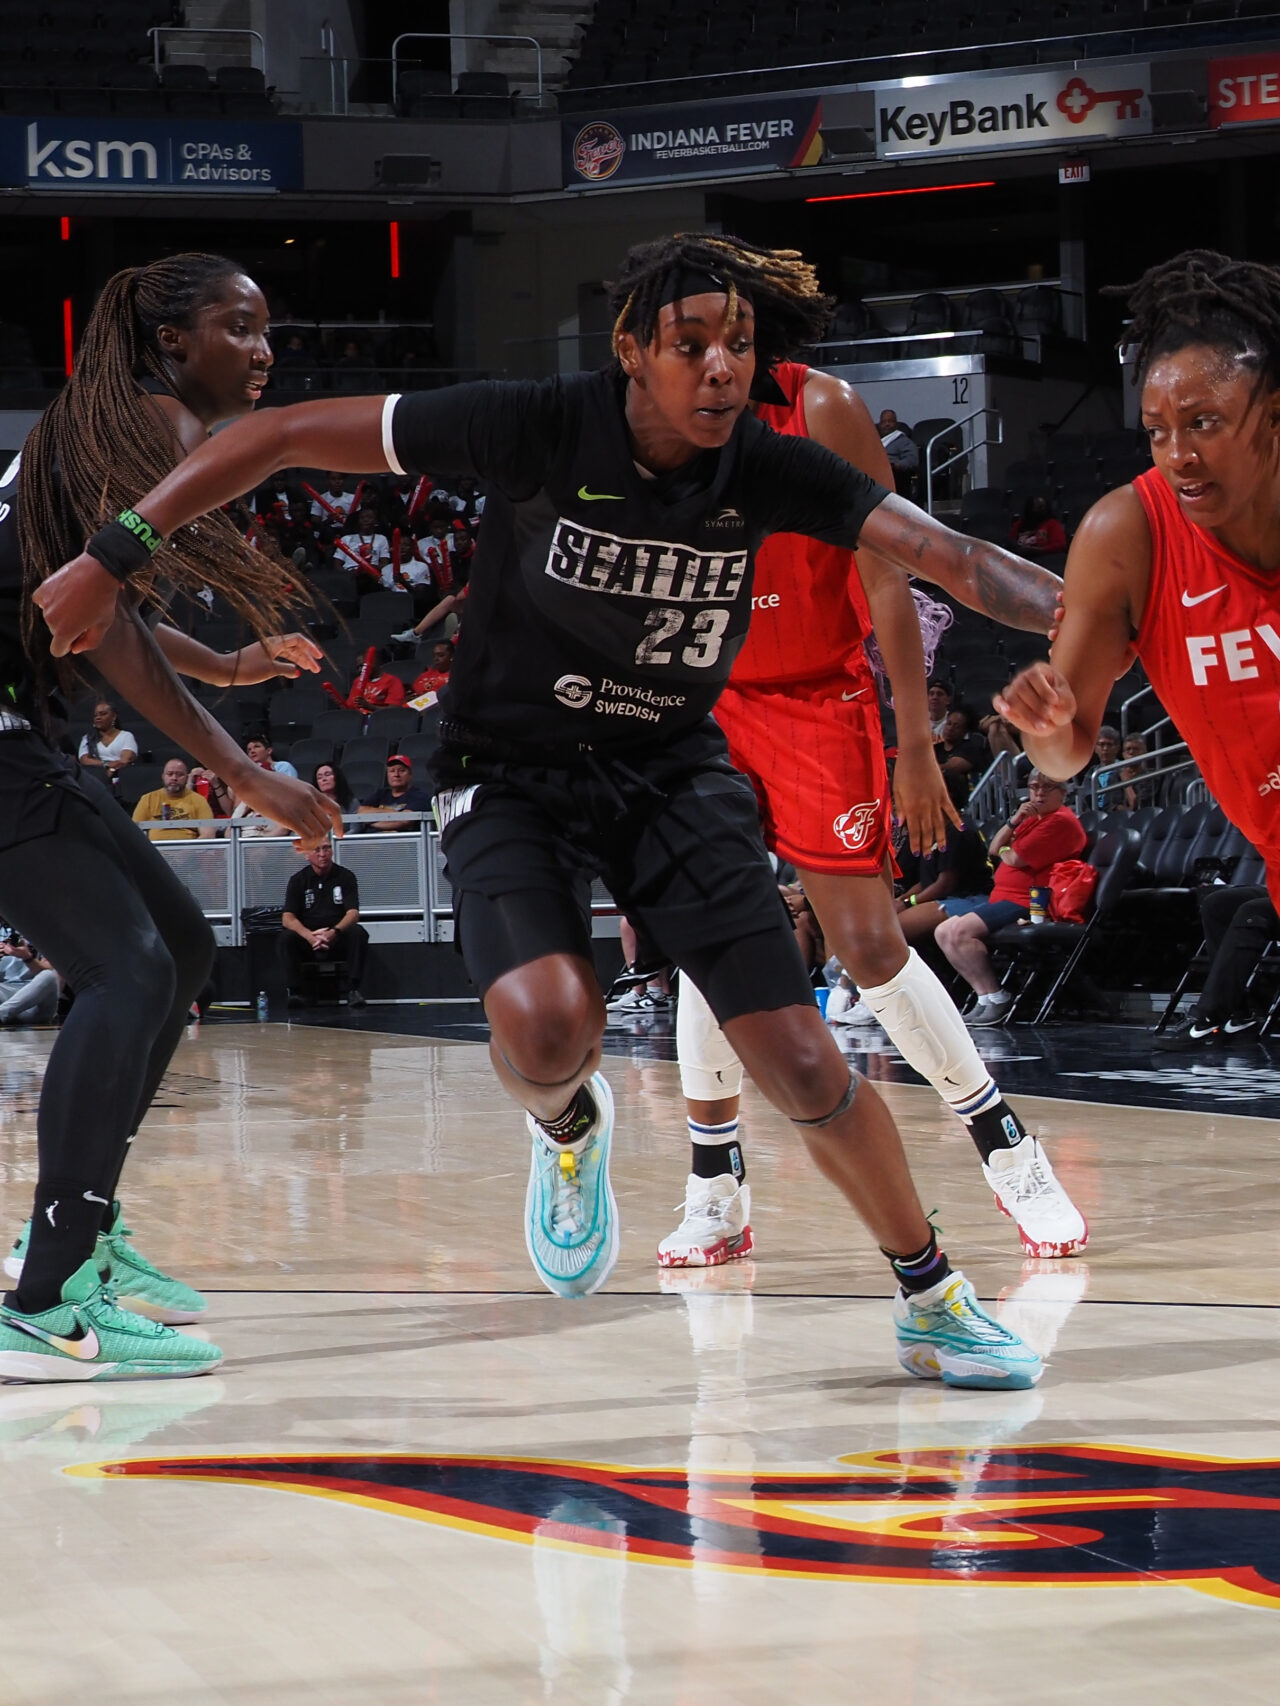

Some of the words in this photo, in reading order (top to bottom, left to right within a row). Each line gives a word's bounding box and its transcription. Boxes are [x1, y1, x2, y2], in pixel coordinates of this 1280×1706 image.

[879, 93, 1050, 146] KeyBank
[631, 125, 723, 151] INDIANA
[726, 119, 795, 142] FEVER
[27, 121, 158, 179] ksm
[183, 142, 234, 161] CPAs
[236, 143, 252, 161] &
[656, 140, 770, 160] FEVERBASKETBALL.COM
[183, 163, 272, 182] Advisors
[1064, 165, 1085, 180] EXIT
[952, 377, 969, 405] 12
[550, 522, 746, 600] SEATTLE
[635, 607, 731, 668] 23
[599, 677, 686, 708] Providence
[594, 699, 661, 724] SWEDISH
